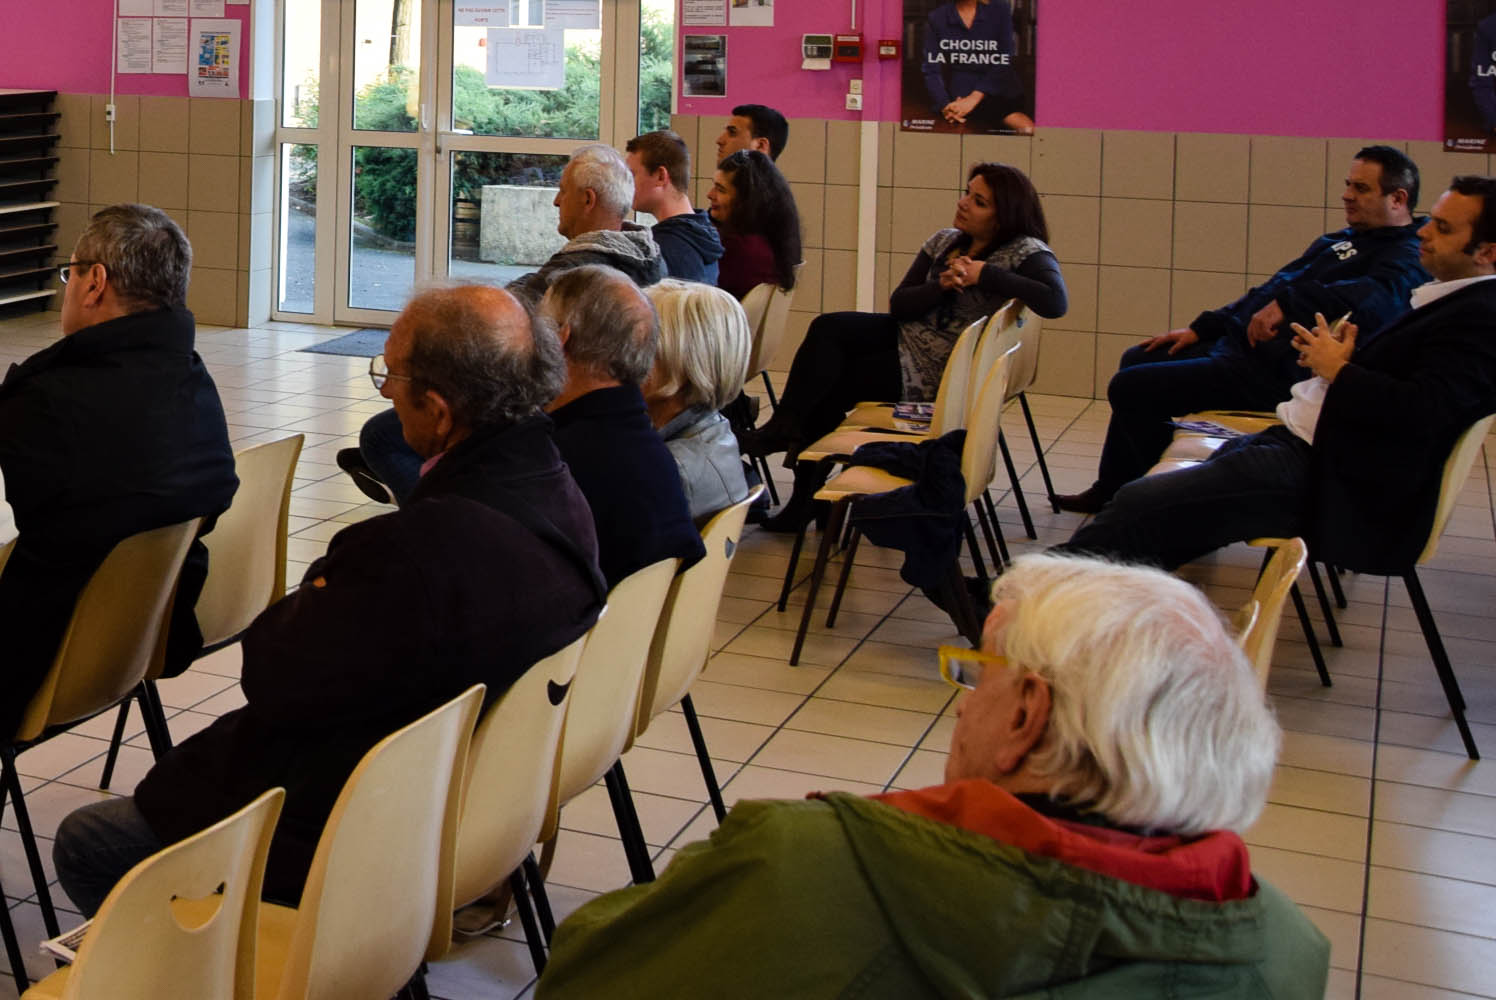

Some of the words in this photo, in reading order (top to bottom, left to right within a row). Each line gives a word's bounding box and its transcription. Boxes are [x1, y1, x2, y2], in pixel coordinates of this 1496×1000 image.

[939, 39, 998, 50] CHOISIR
[927, 52, 946, 63] LA
[950, 53, 1010, 65] FRANCE
